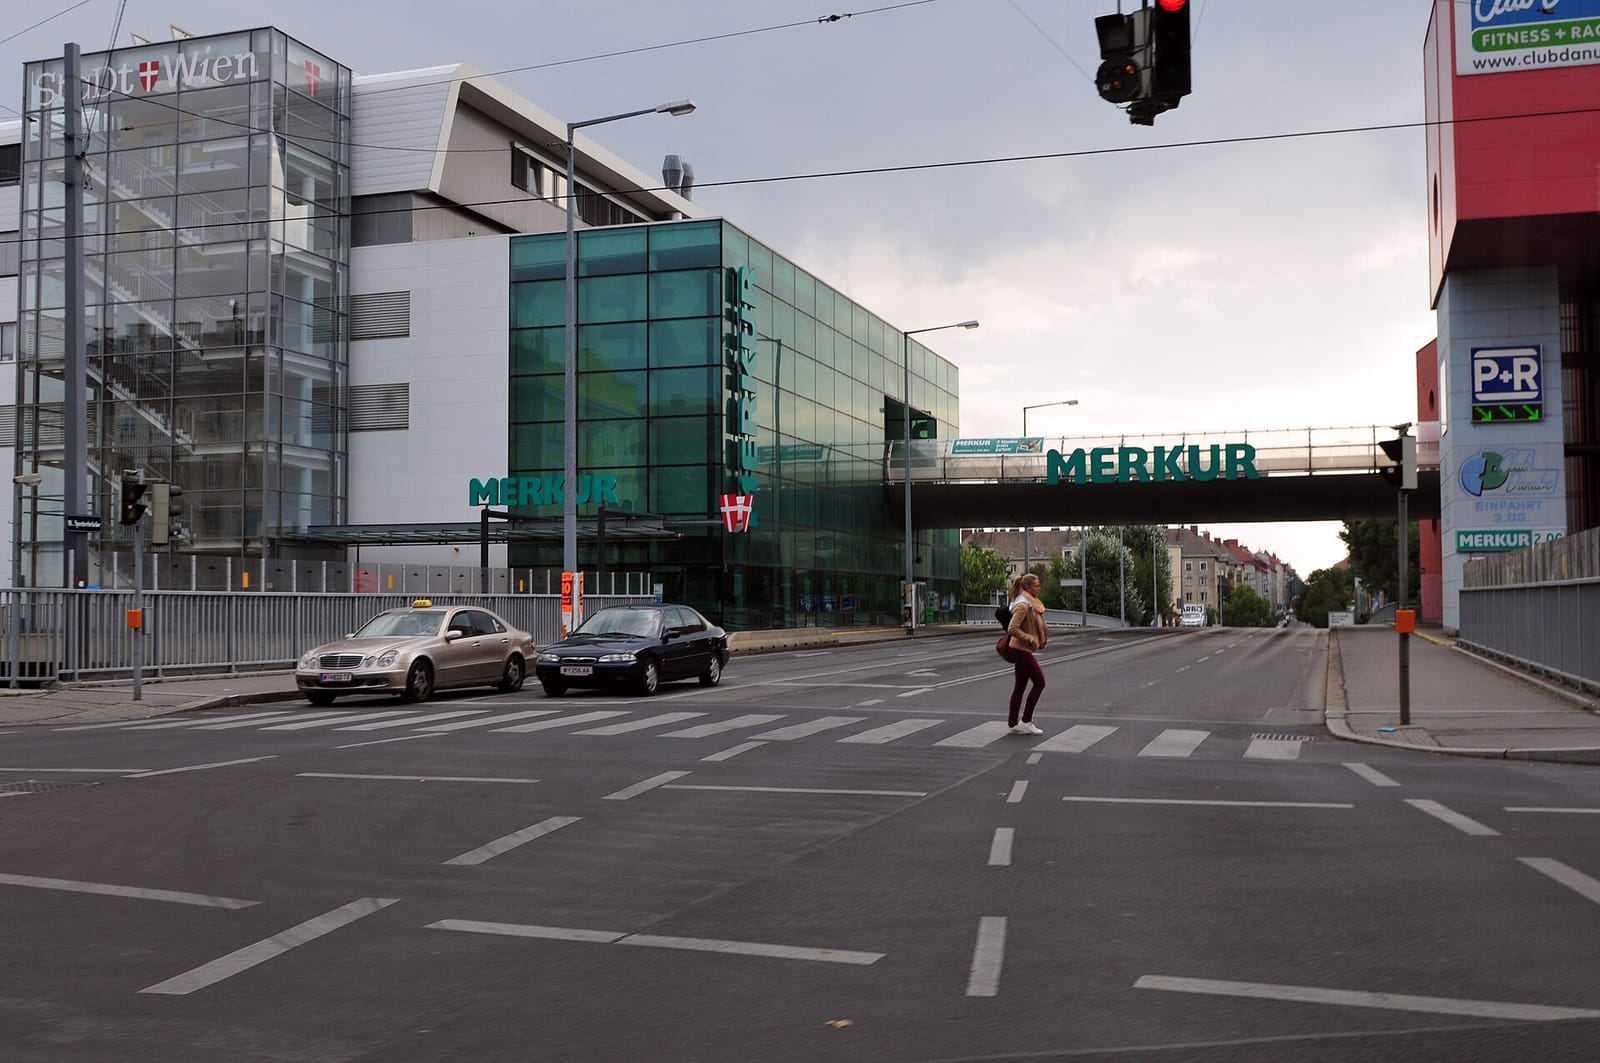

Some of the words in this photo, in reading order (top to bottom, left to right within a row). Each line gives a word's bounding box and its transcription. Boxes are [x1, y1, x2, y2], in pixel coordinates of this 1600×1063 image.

[1482, 29, 1550, 46] FITNESS
[164, 46, 259, 89] Wien
[1473, 48, 1600, 69] www.clubdanu
[1474, 357, 1539, 392] P+R
[1046, 443, 1259, 485] MERKUR
[1475, 500, 1543, 511] EINFAHRT
[1459, 533, 1530, 547] MERKUR
